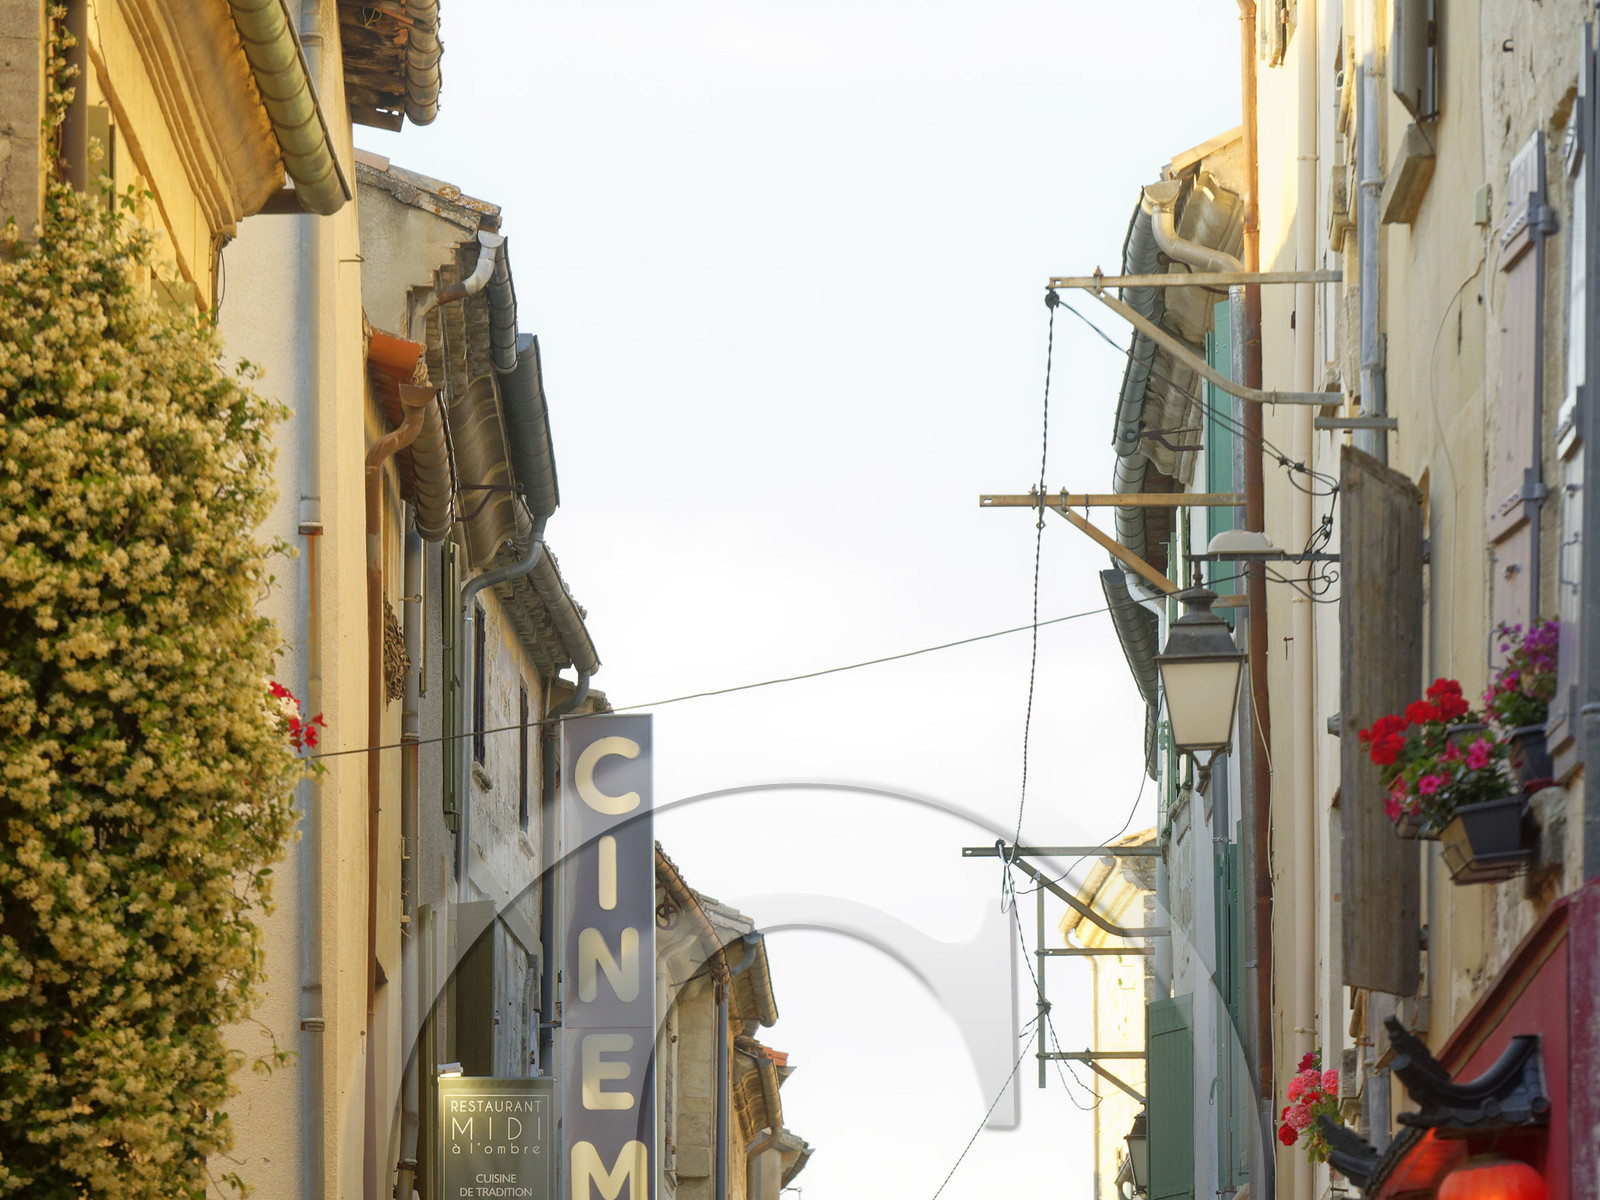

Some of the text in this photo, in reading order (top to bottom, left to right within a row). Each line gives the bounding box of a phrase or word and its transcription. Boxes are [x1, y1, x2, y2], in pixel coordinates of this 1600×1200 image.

[450, 1100, 542, 1113] RESTAURANT
[452, 1116, 541, 1141] MIDI
[452, 1142, 541, 1155] à l'ombre
[475, 1173, 517, 1184] CUISINE
[459, 1187, 533, 1197] DE TRADITION
